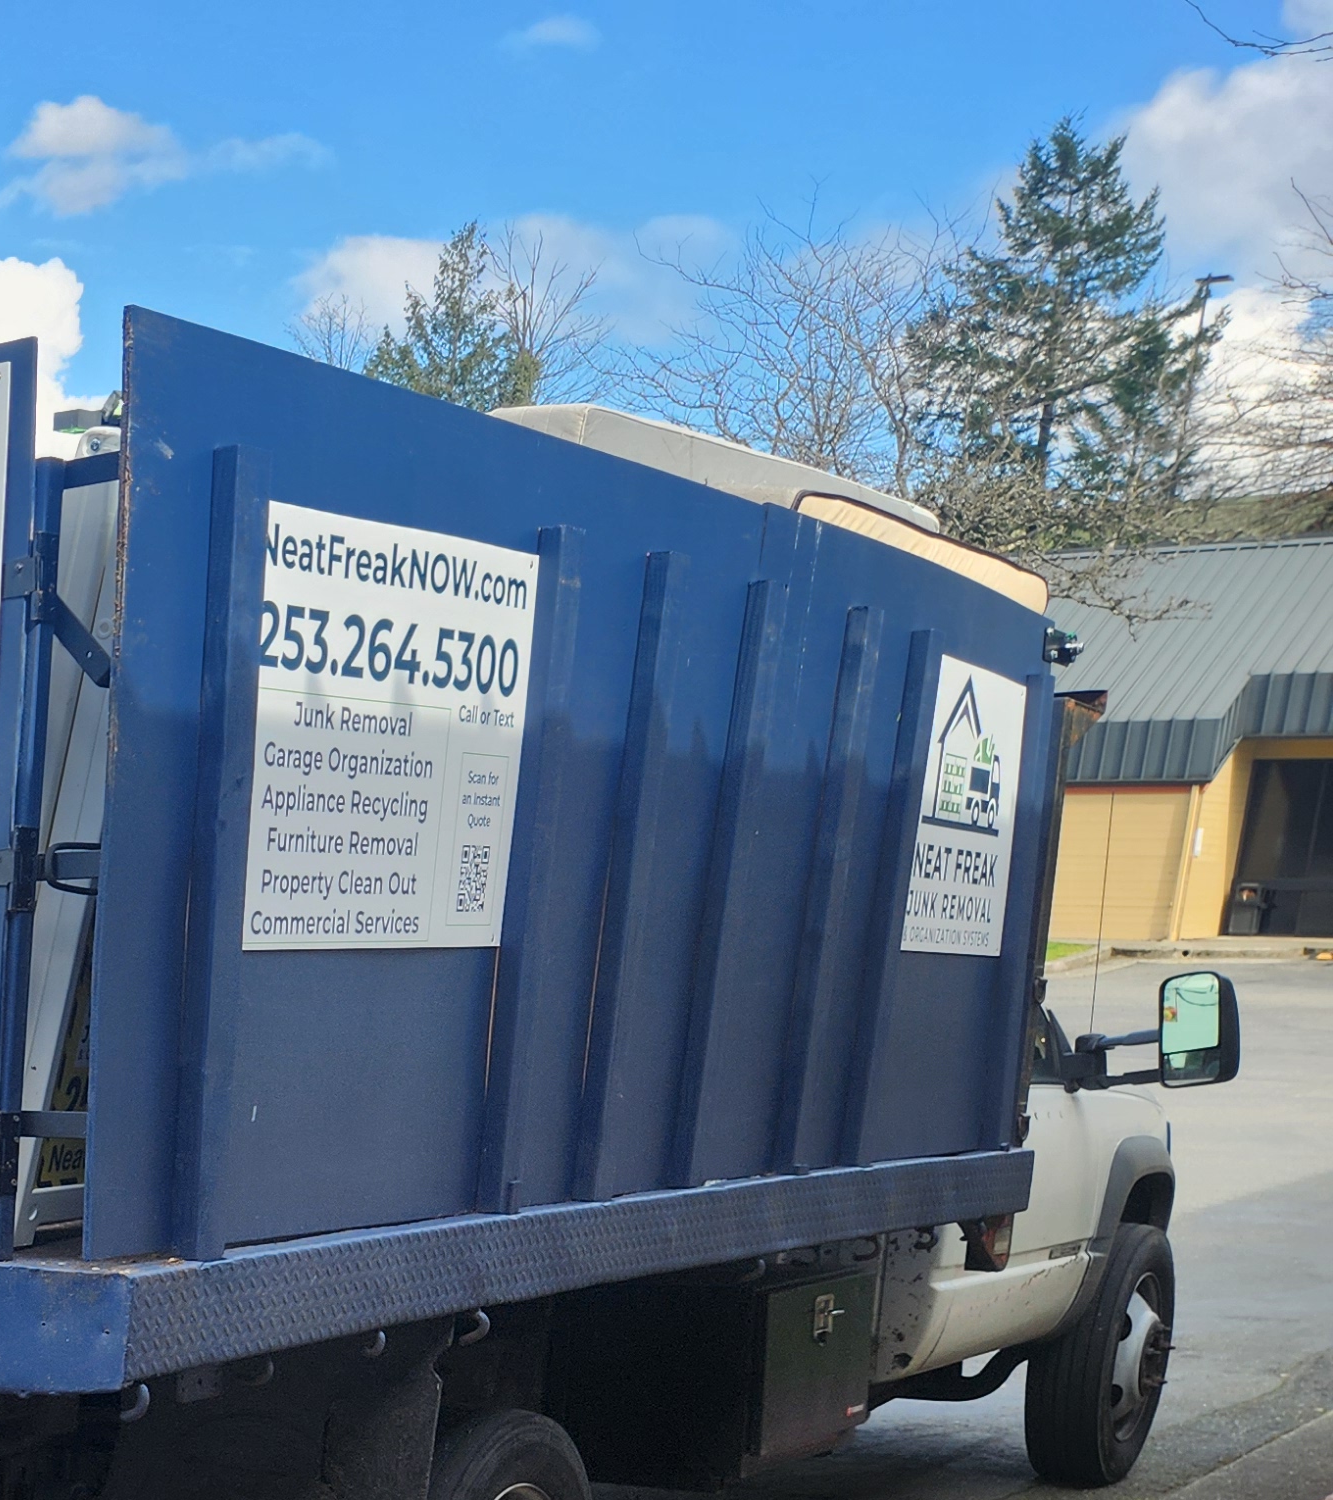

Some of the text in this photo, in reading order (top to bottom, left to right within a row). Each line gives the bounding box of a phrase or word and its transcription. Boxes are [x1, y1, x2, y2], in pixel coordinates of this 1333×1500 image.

[266, 524, 528, 610] NeatFreakNOW.com
[260, 600, 519, 698] 253.264.5300
[293, 702, 413, 737] Junk Removal
[459, 705, 515, 729] Call or Text
[264, 742, 433, 780] Garage Organization
[467, 771, 499, 786] Scan for
[261, 785, 428, 824] Appliance Recycling
[462, 791, 500, 808] an Instant
[467, 814, 491, 829] Quote
[267, 828, 418, 857] Furniture Removal
[913, 842, 998, 887] NEAT FREAK
[261, 870, 417, 900] Property Clean Out
[906, 890, 991, 923] JUNK REMOVAL
[250, 910, 419, 935] Commercial Services
[909, 926, 961, 945] ORGANIZATION
